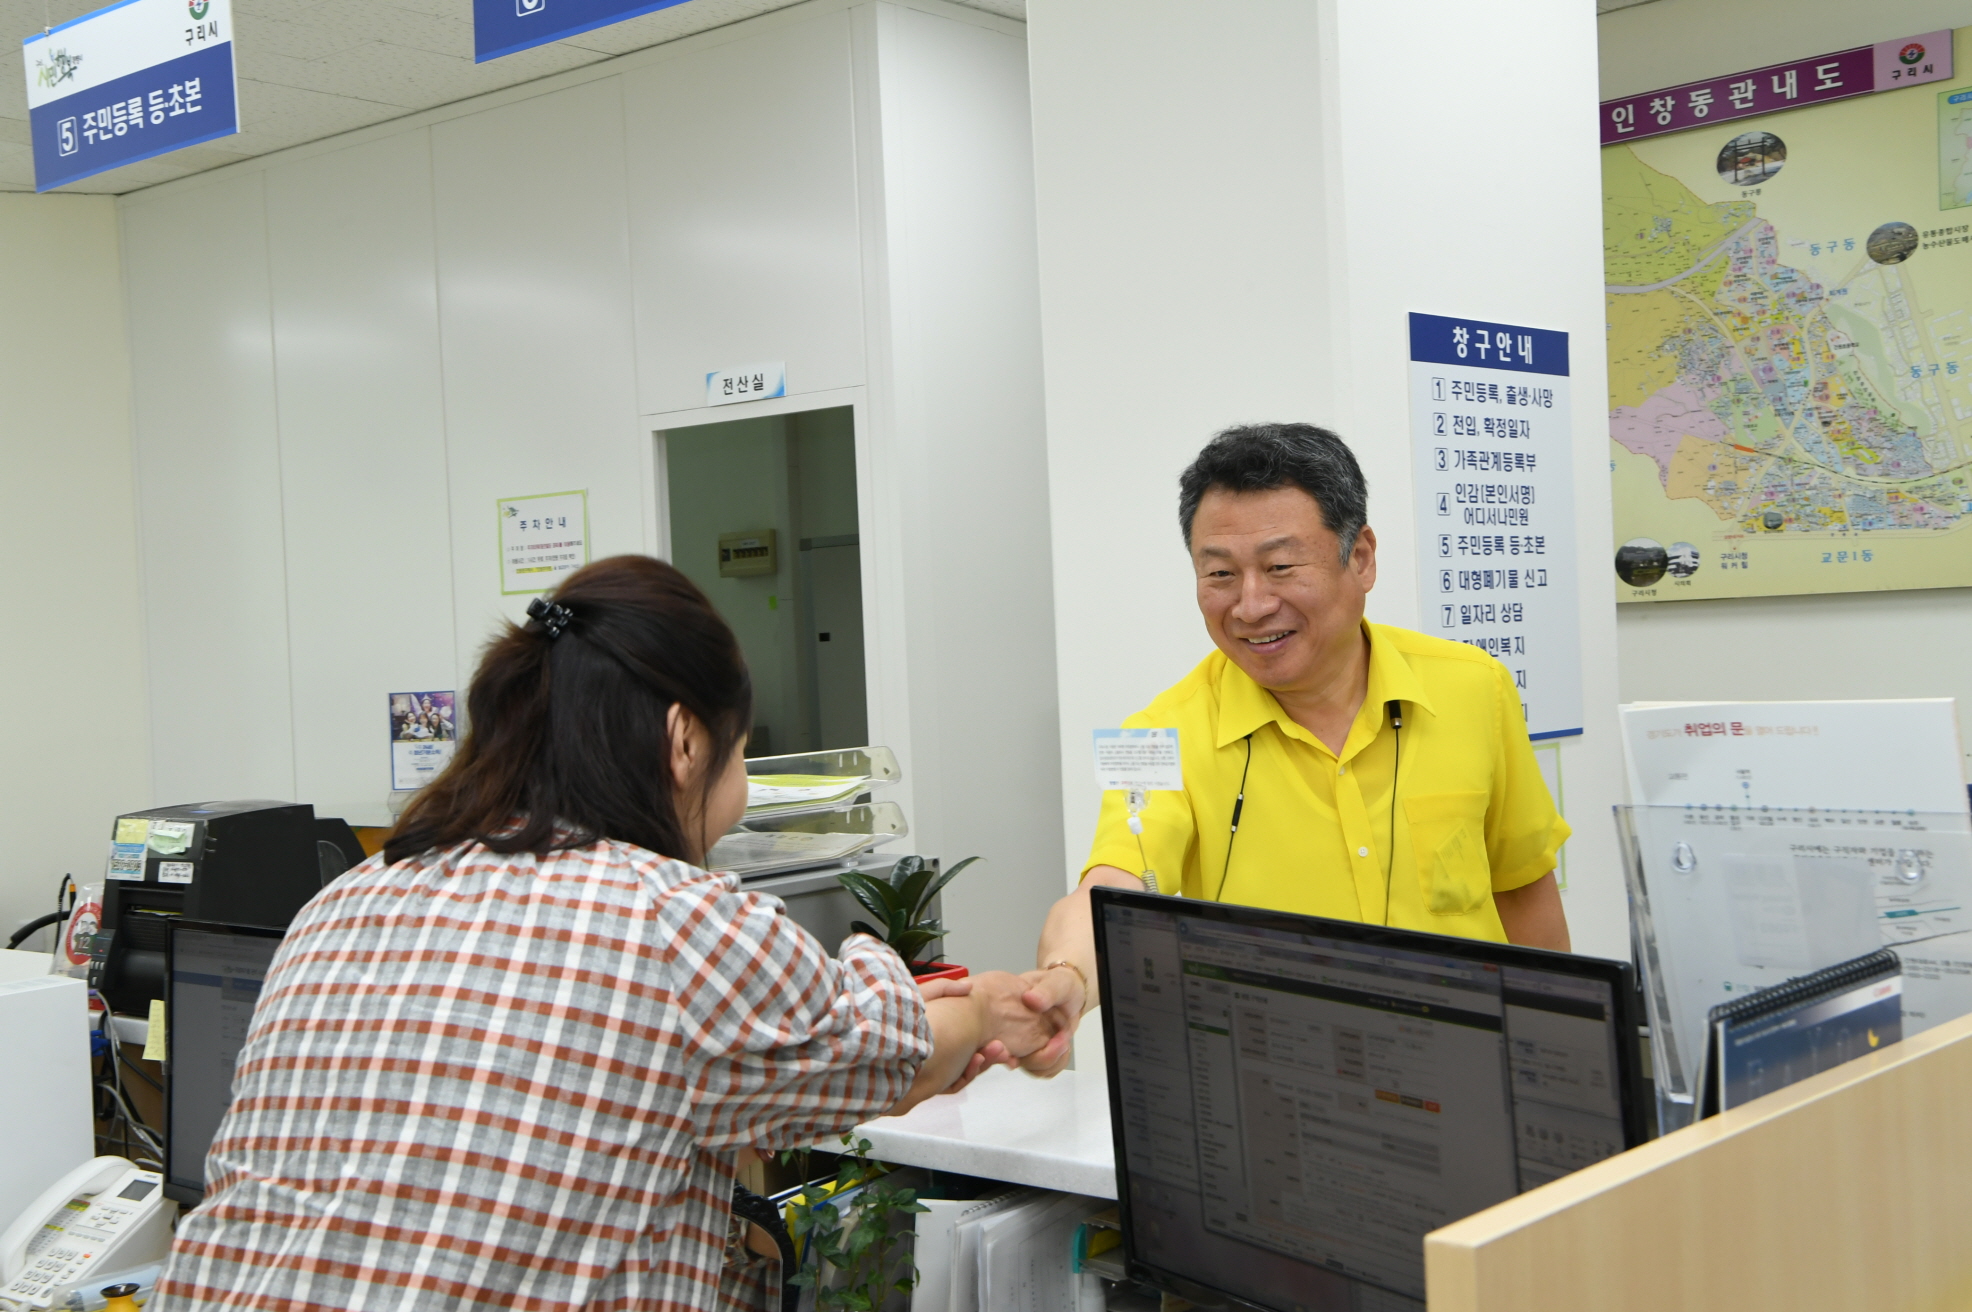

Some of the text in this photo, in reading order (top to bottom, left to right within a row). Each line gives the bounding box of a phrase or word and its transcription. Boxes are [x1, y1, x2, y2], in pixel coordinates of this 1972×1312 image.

[185, 20, 218, 46] 구리시
[1891, 63, 1934, 80] 구리시
[61, 121, 74, 151] 5
[82, 96, 144, 145] 주민등록
[1809, 237, 1856, 256] 동구동
[1452, 326, 1533, 365] 창구안내
[1910, 361, 1960, 379] 동구동
[722, 372, 764, 396] 전산실
[1451, 380, 1502, 404] 주민등록,
[1436, 414, 1531, 439] 2 전입, 확정일자
[1438, 449, 1536, 472] 3 가족관계등록부
[1439, 494, 1448, 513] 4
[1464, 507, 1529, 526] 어디서나민원
[1441, 536, 1450, 555] 5
[1457, 535, 1505, 556] 주민등록
[1442, 568, 1548, 591] 6 대형폐기물 신고
[1444, 602, 1524, 625] 7 일자리 상담
[1684, 722, 1727, 737] 취업의
